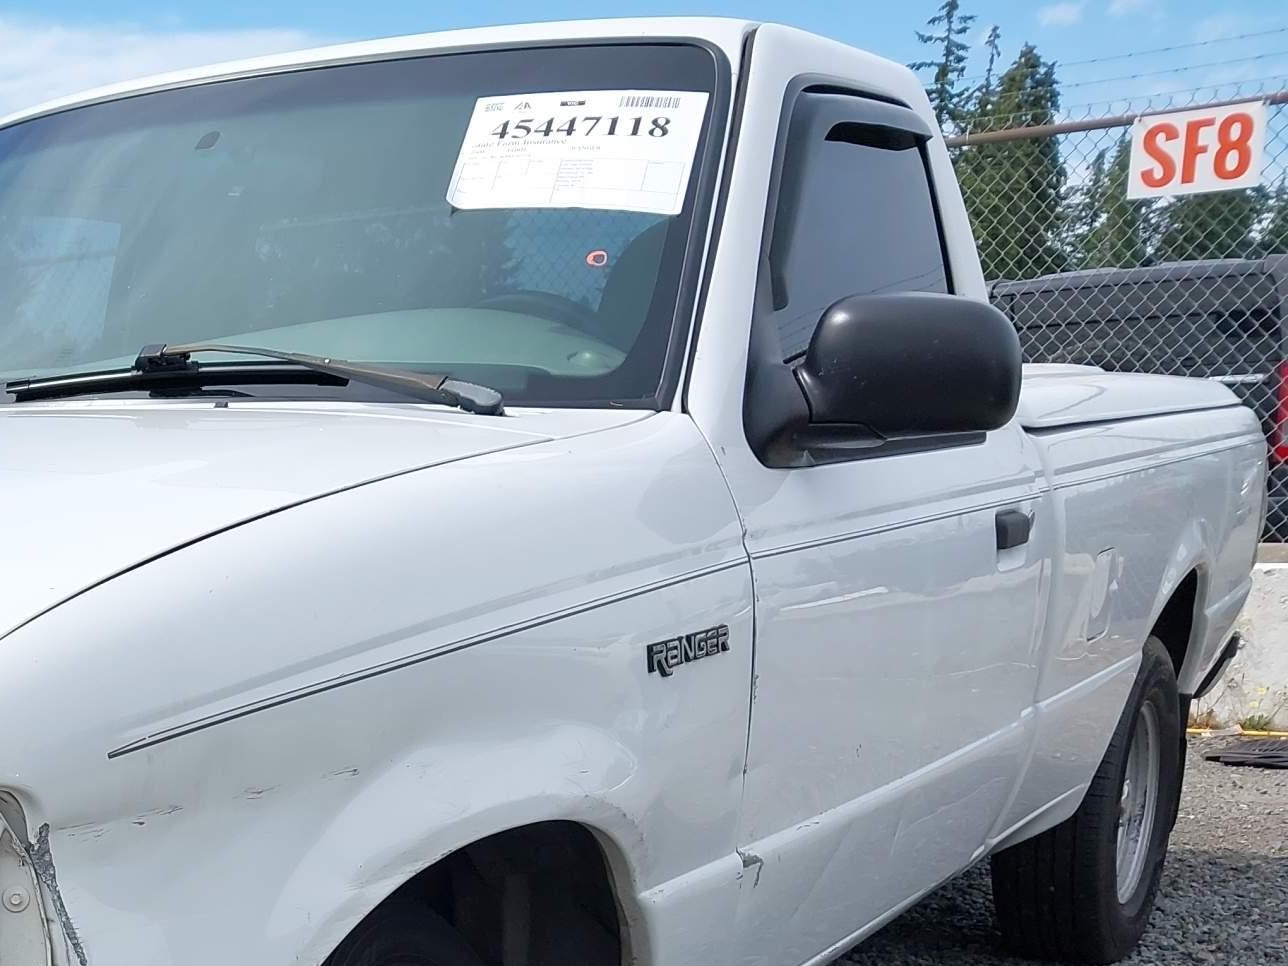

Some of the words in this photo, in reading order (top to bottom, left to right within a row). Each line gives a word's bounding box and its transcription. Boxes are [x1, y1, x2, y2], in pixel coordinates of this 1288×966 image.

[488, 116, 672, 139] 45447118
[1140, 112, 1255, 188] SF8
[646, 623, 731, 678] RANGER
